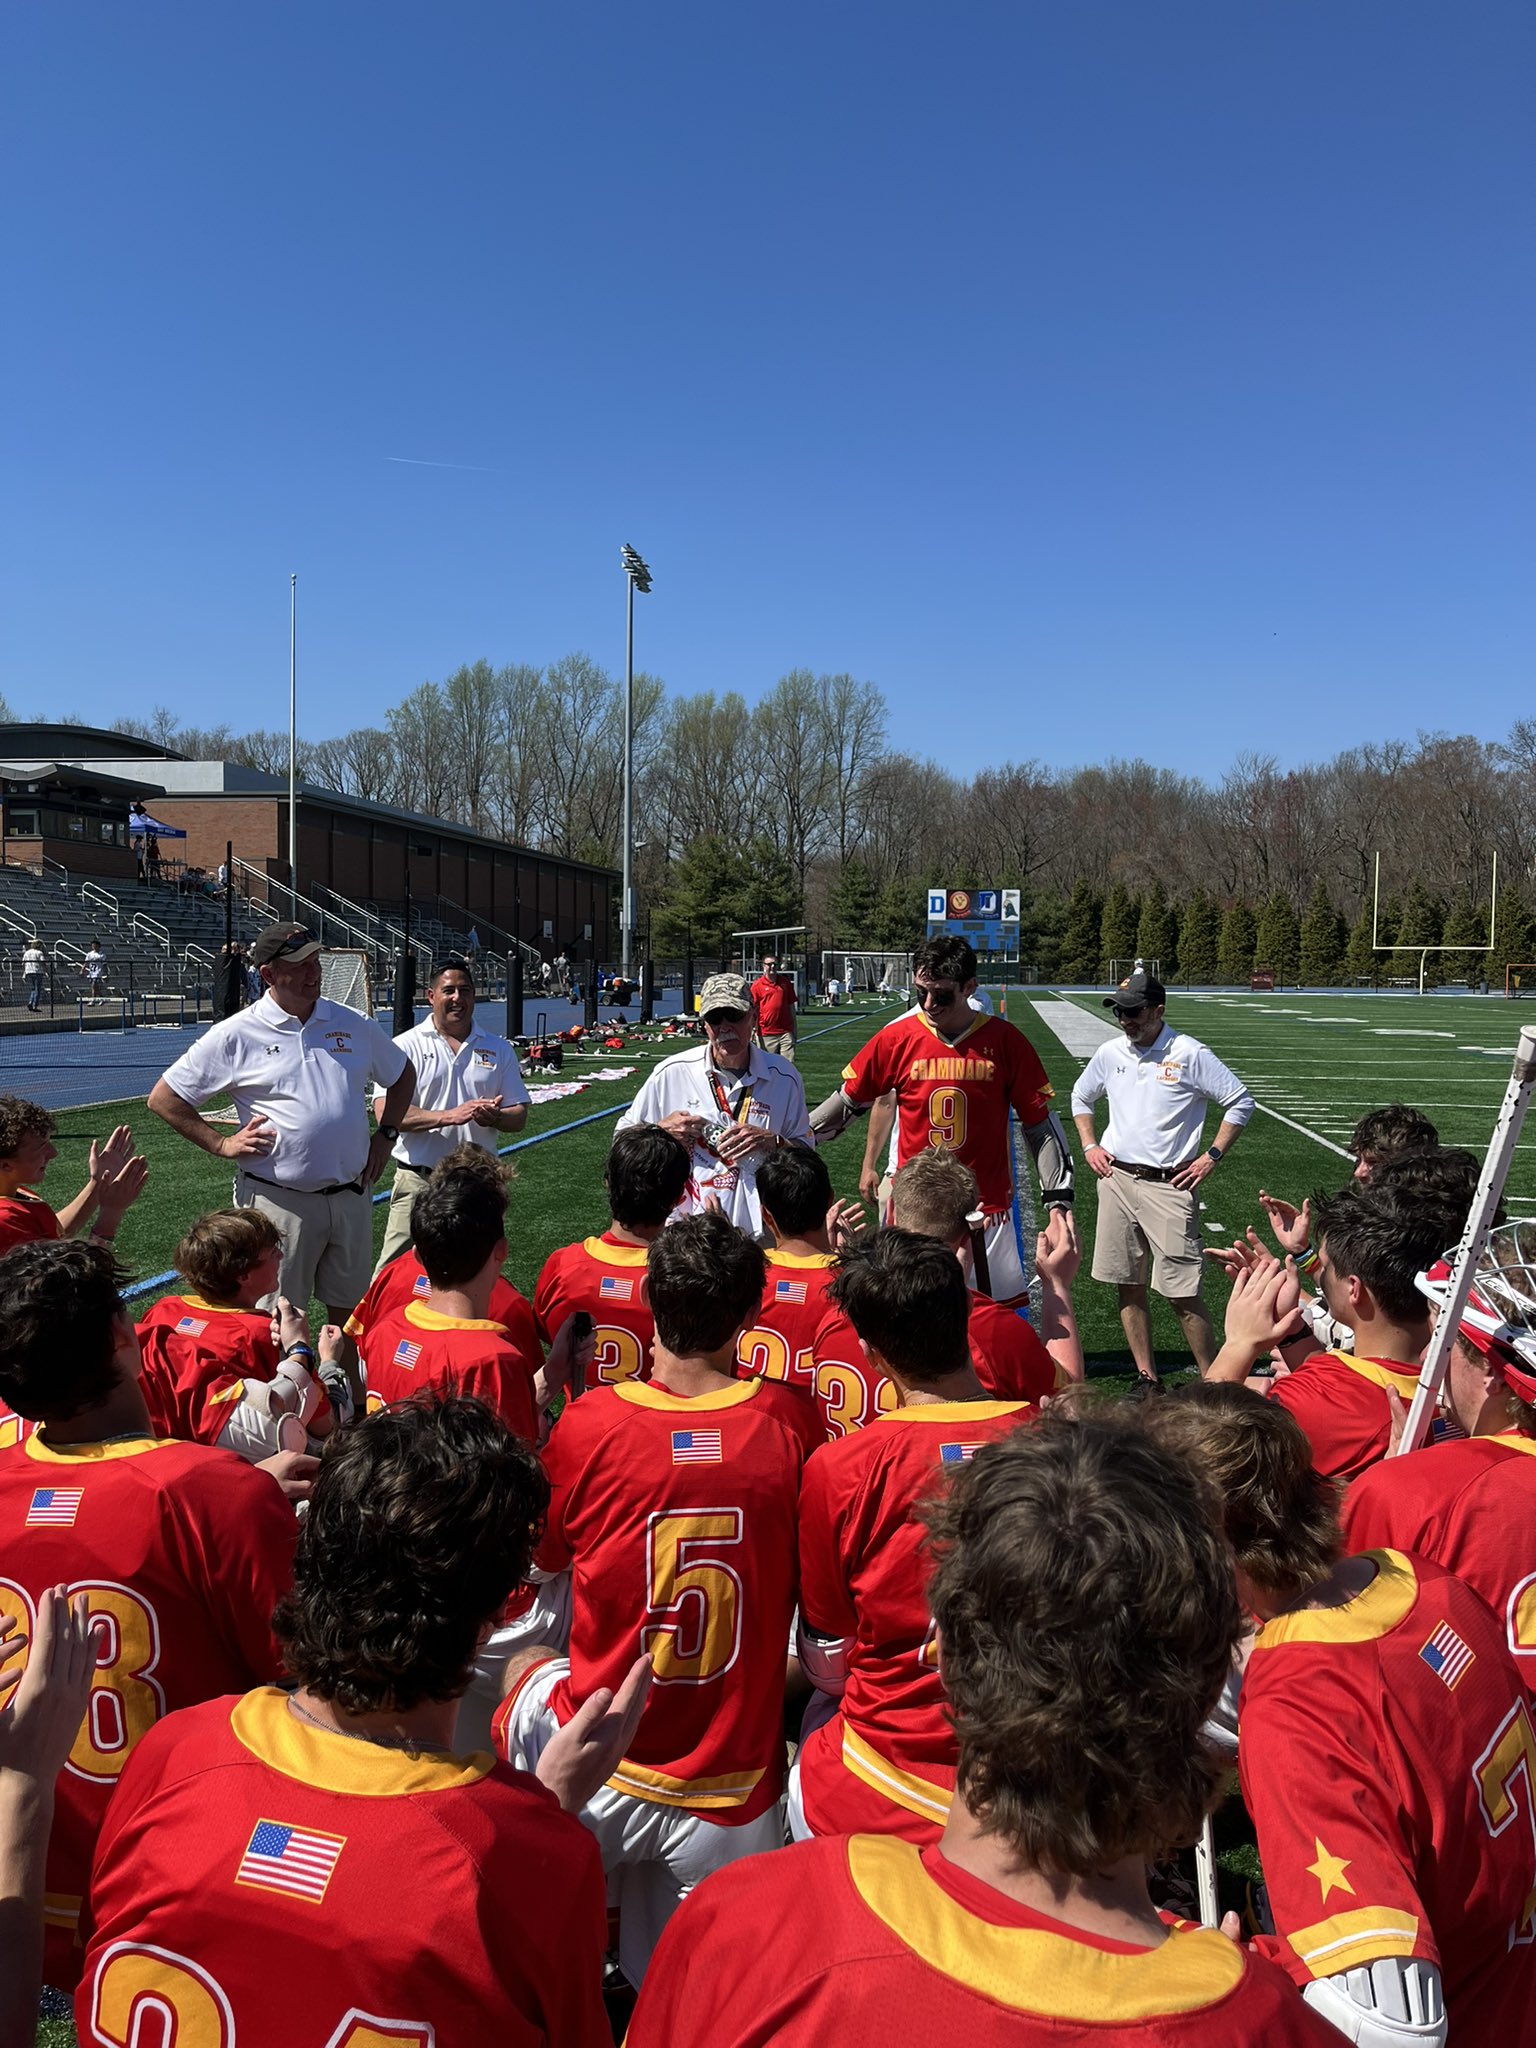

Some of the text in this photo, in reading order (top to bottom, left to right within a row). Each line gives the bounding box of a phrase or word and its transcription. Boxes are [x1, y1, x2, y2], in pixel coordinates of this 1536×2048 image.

[930, 896, 945, 914] D
[336, 1037, 345, 1048] C
[910, 1057, 997, 1081] CHAMINADE
[1164, 1067, 1173, 1077] C
[928, 1086, 968, 1151] 9
[640, 1507, 743, 1685] 5
